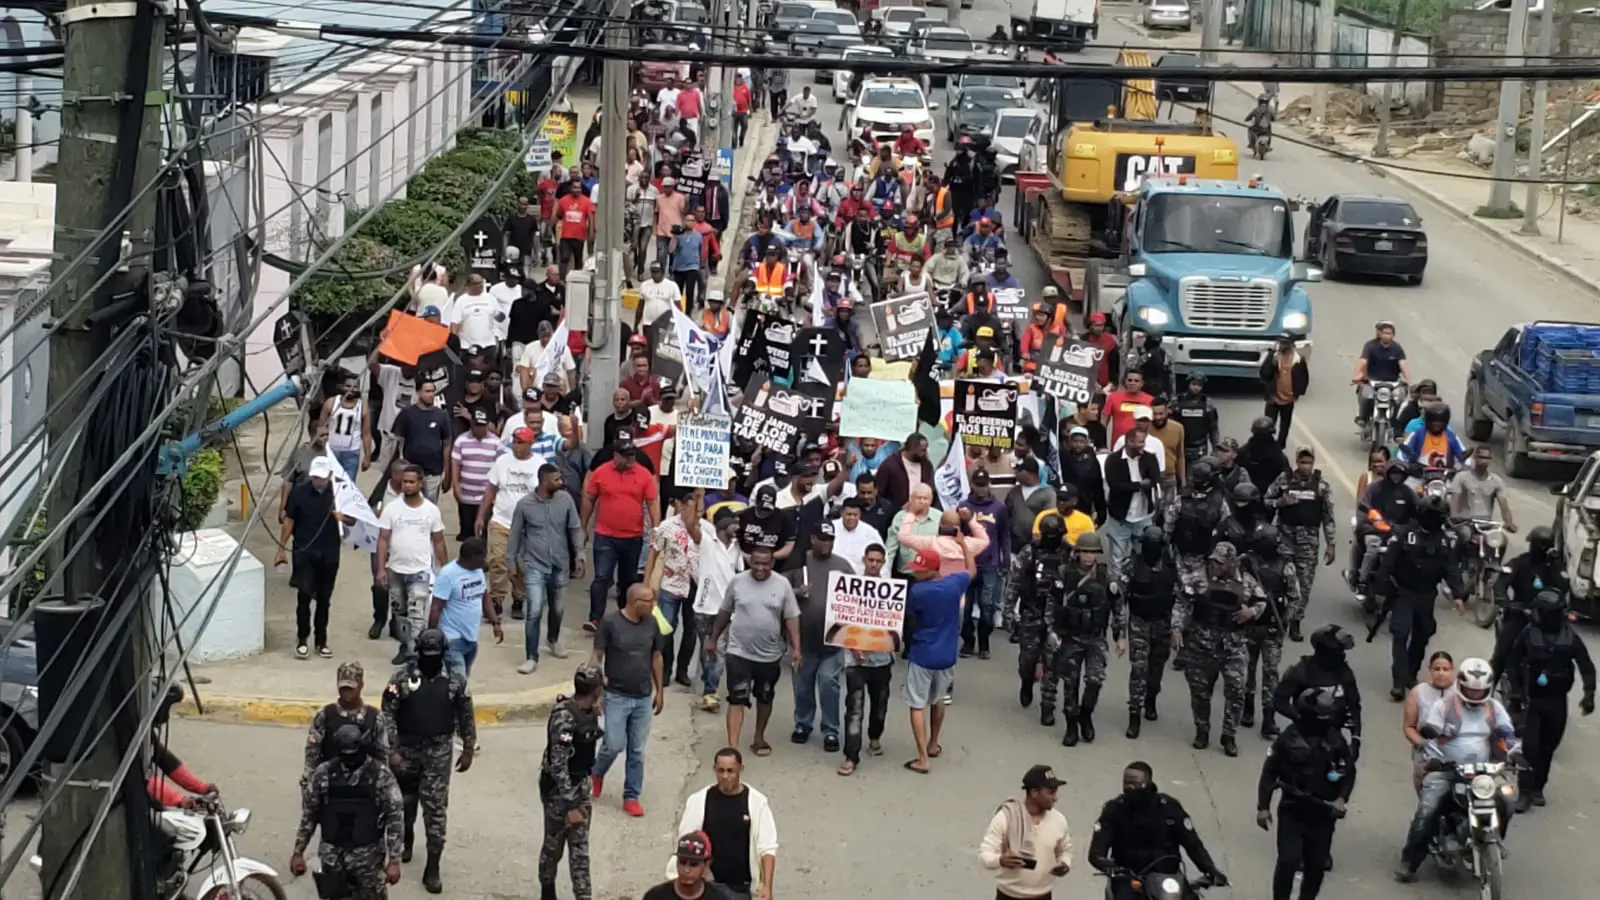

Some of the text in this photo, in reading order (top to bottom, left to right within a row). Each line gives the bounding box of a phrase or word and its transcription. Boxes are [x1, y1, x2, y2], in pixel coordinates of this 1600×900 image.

[1044, 380, 1090, 403] LUTO
[741, 404, 766, 421] TAMO
[956, 414, 1014, 428] EL GOBIERNO
[335, 412, 354, 435] 11
[743, 416, 788, 441] DE LOS
[959, 423, 1009, 437] NOS ESTA
[681, 440, 724, 455] SOLO PARA
[733, 422, 790, 454] TAPONES
[834, 576, 906, 601] ARROZ
[859, 598, 904, 611] HUEVO
